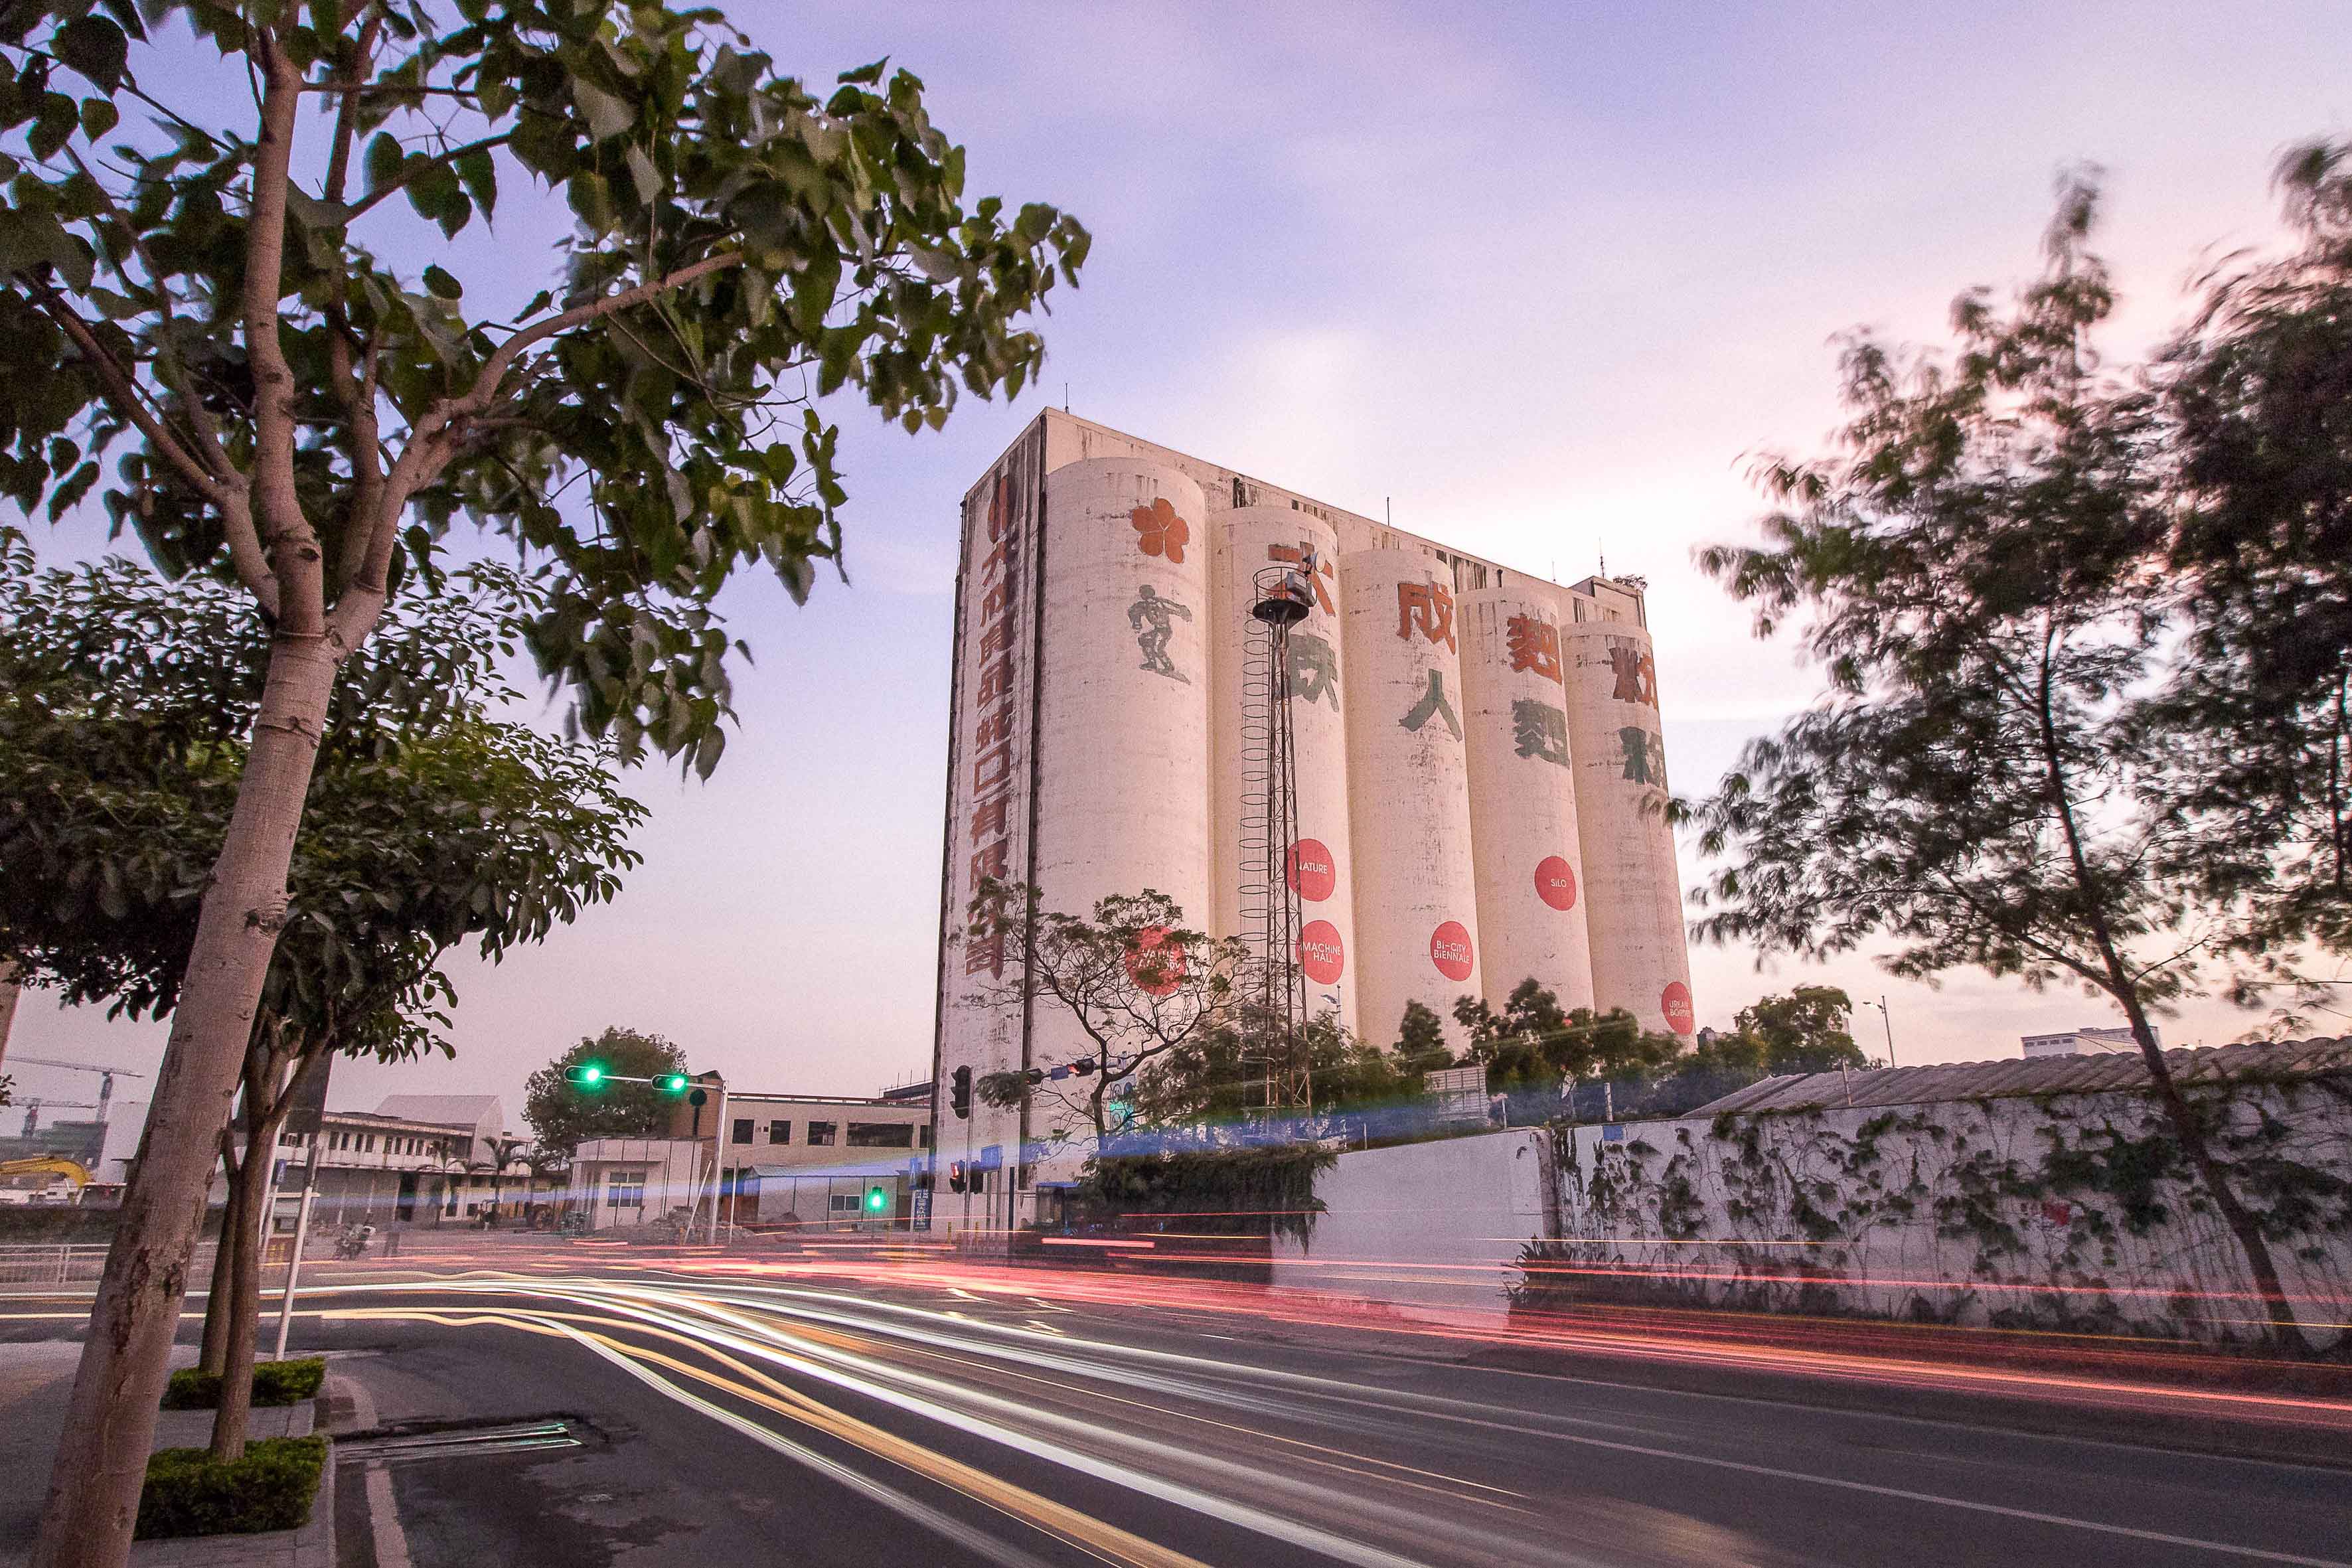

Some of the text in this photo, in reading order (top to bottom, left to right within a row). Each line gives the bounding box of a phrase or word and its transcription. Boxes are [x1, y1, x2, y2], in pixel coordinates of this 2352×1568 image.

[1550, 878, 1567, 888] SILO
[1298, 941, 1341, 956] MACHINE
[1313, 951, 1334, 964] HALL
[1433, 949, 1470, 964] BIENNALE
